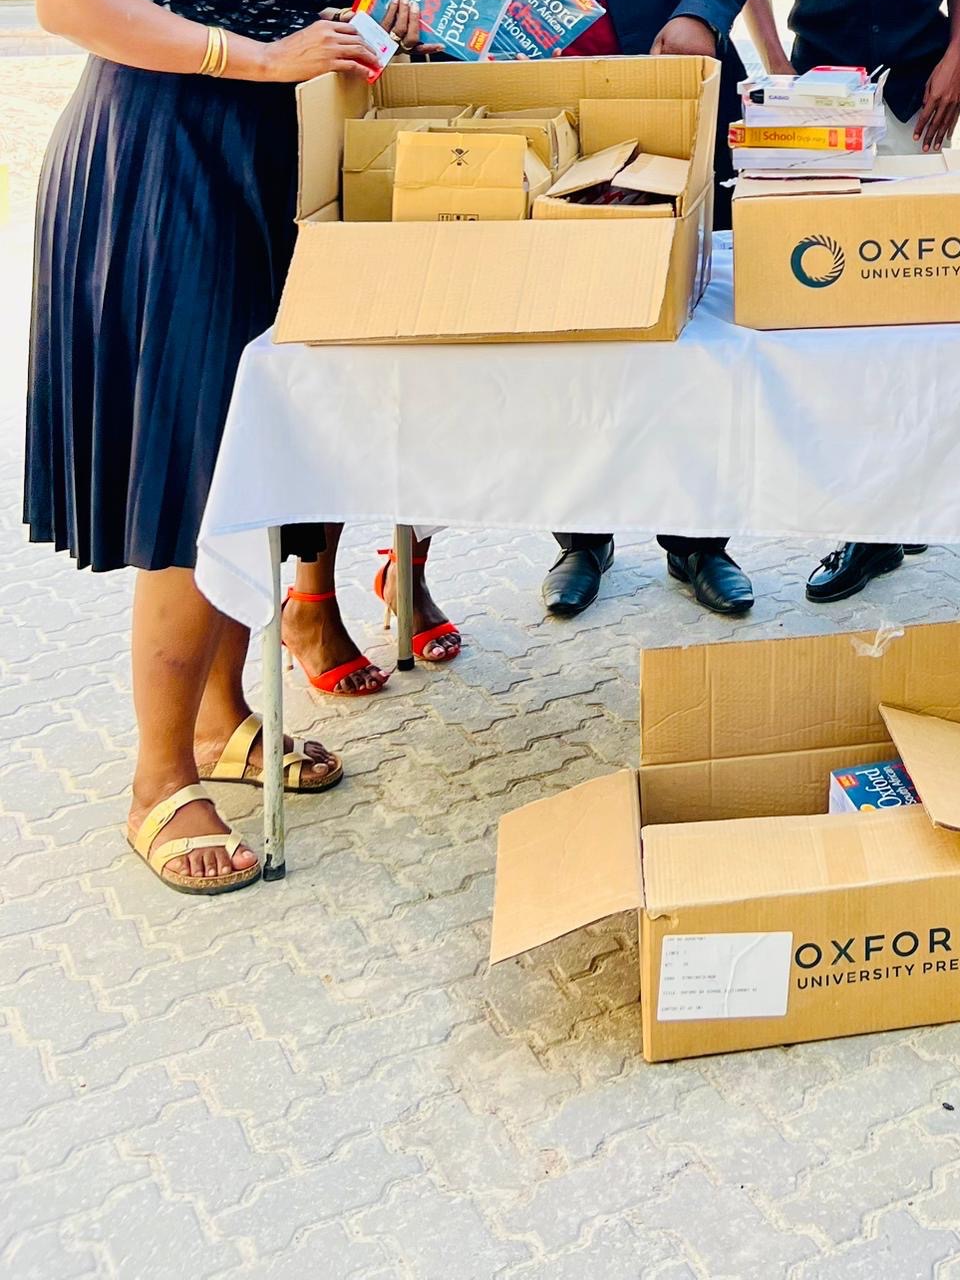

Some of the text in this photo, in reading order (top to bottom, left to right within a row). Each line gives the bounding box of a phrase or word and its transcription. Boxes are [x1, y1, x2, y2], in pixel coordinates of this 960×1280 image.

[435, 0, 458, 37] African
[509, 1, 561, 49] chool
[537, 7, 566, 36] African
[763, 131, 796, 142] School
[861, 265, 960, 280] UNIVERSITY
[855, 767, 902, 809] Oxford
[798, 964, 916, 989] UNIVERSITY
